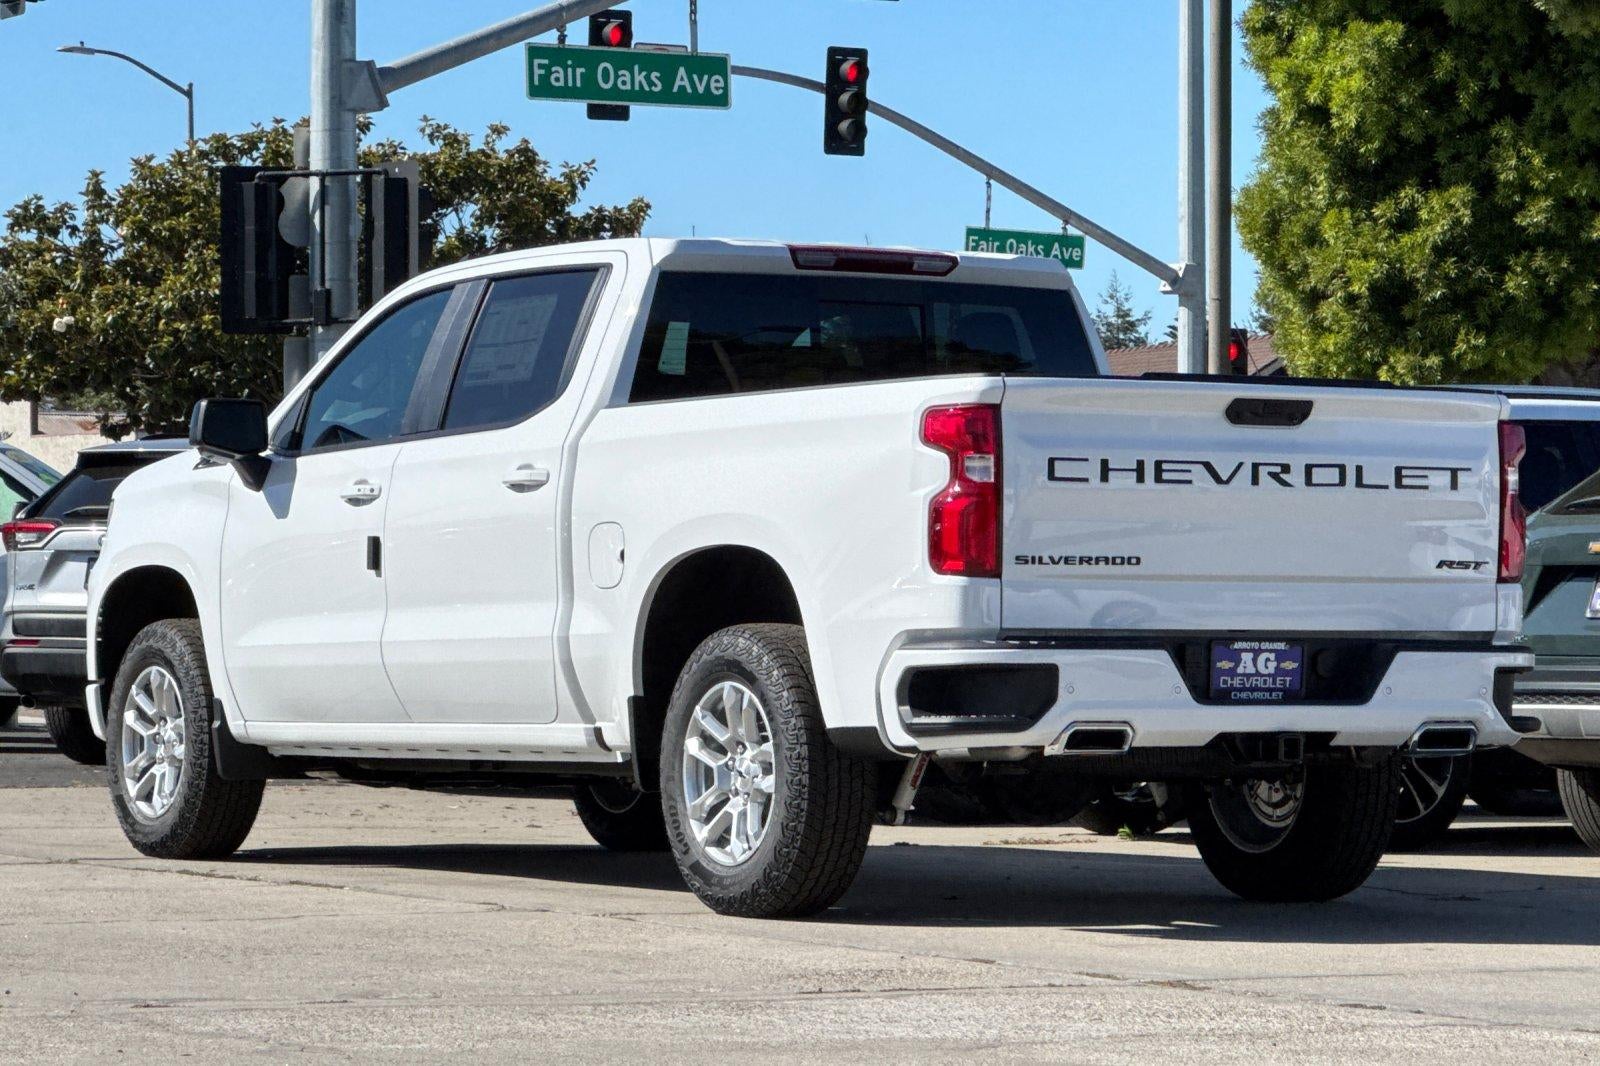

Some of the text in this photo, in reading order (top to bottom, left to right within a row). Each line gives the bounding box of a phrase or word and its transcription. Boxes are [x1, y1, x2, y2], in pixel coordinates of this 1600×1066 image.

[533, 58, 725, 95] Fair Oaks Ave
[968, 235, 1082, 261] Fair Oaks Ave
[1047, 456, 1473, 491] CHEVROLET
[1014, 555, 1142, 566] SILVERADO
[1435, 559, 1490, 571] RST
[1233, 641, 1287, 650] ARROYO GRANDE
[1236, 652, 1278, 674] AG
[1220, 676, 1293, 688] CHEVROLET
[1231, 691, 1284, 700] CHEVROLET
